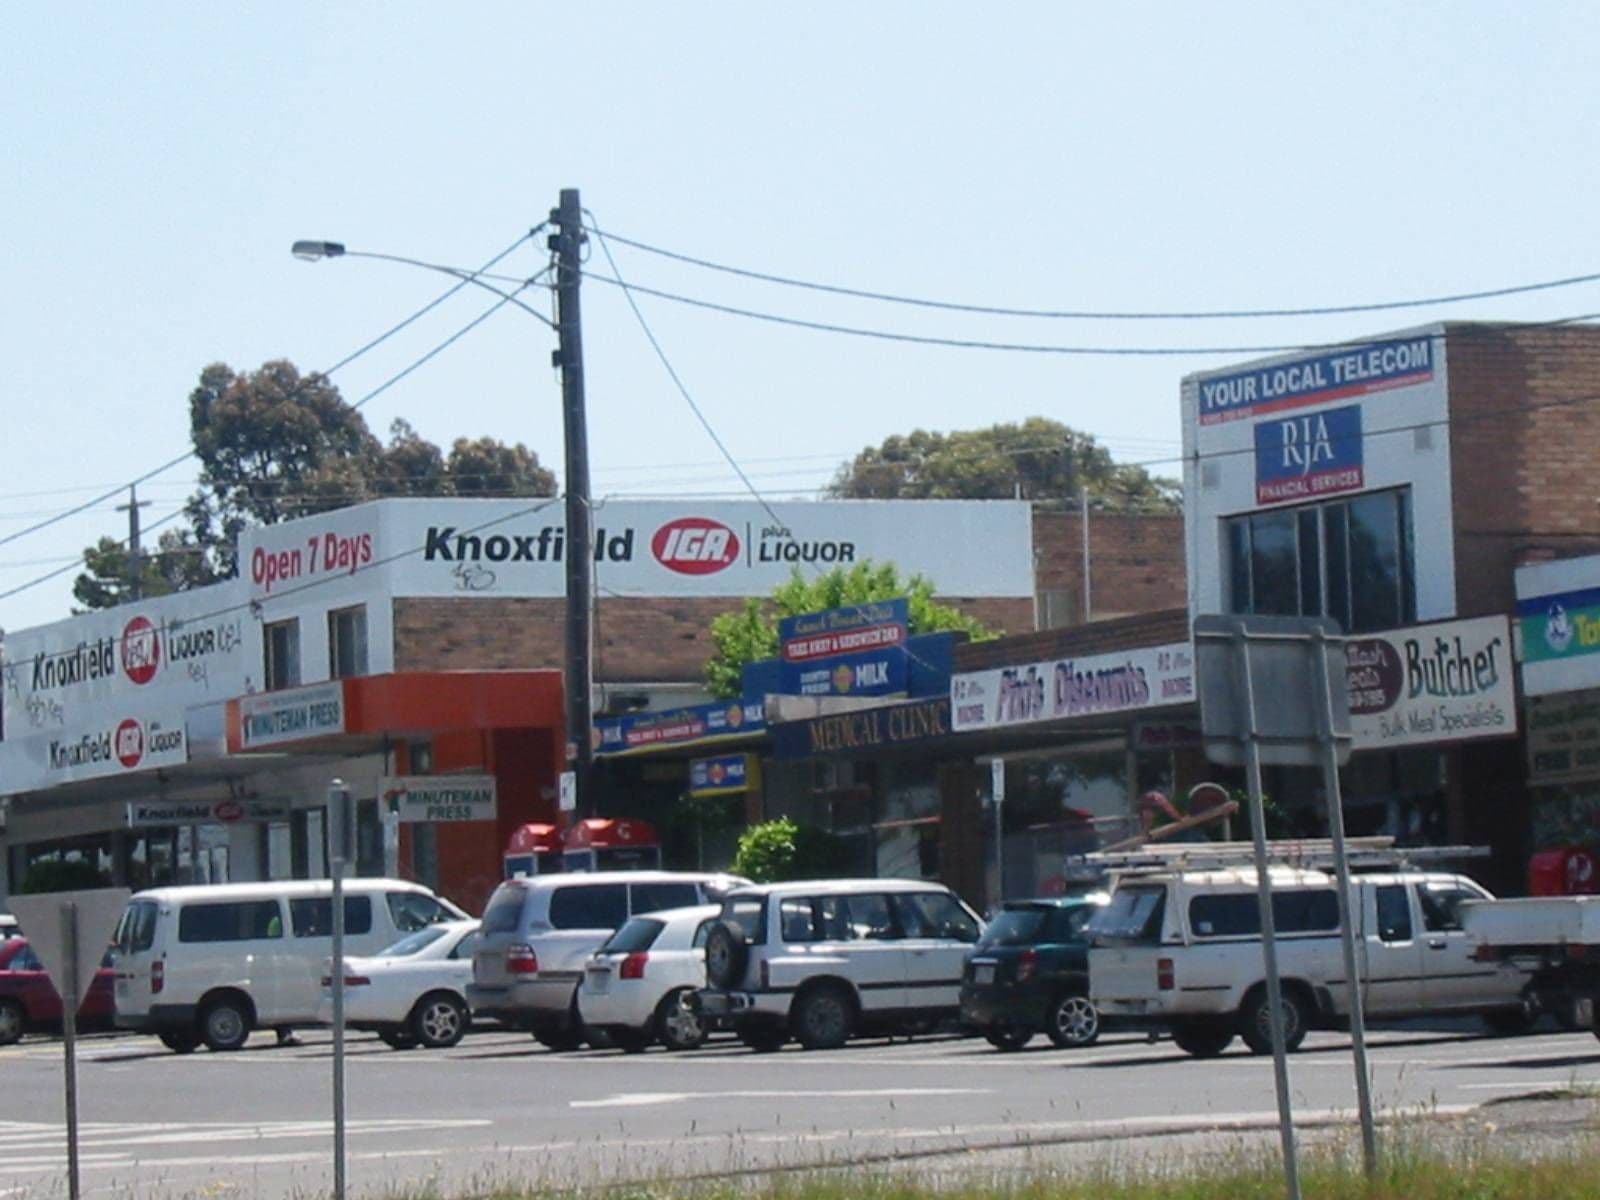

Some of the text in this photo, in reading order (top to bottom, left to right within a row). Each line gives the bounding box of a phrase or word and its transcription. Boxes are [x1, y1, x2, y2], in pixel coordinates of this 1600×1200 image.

[1203, 376, 1257, 409] YOUR
[1262, 362, 1327, 397] LOCAL
[1330, 340, 1429, 383] TELECOM
[1281, 414, 1335, 476] RJA
[252, 532, 372, 592] Open 7 Days
[424, 526, 730, 562] Knoxfild IGA
[758, 541, 855, 563] LIQUOR
[32, 637, 115, 691] Knoxfield
[170, 629, 214, 662] LIQUOR
[856, 662, 889, 687] MILK
[1405, 635, 1503, 699] Butcher
[810, 701, 948, 752] MEDICAL CLINIC
[50, 731, 112, 771] Knoxfield
[138, 806, 210, 820] Knoxfield
[406, 789, 492, 803] MINUTEMAN
[427, 805, 472, 819] PRESS
